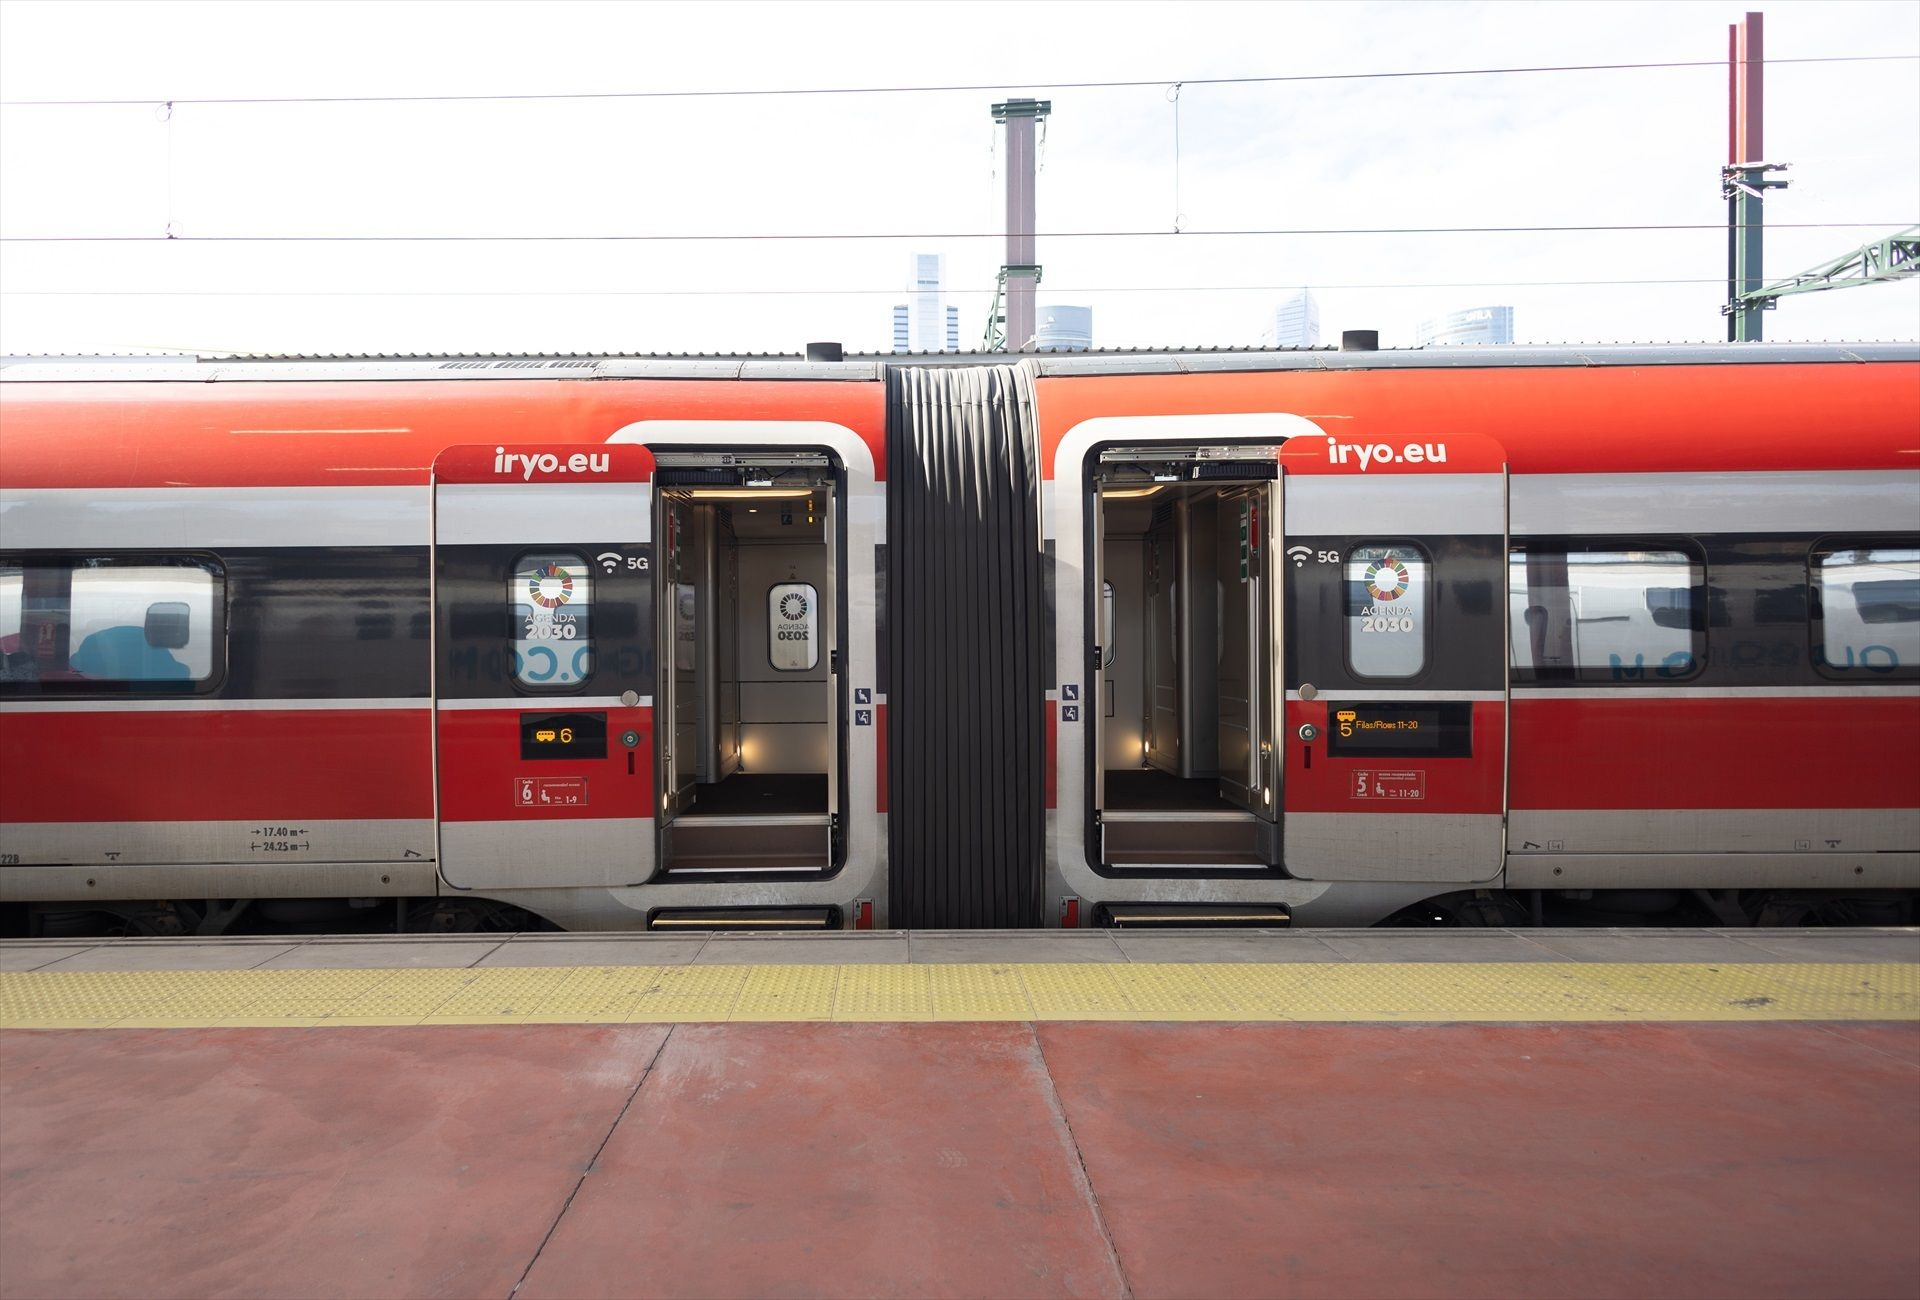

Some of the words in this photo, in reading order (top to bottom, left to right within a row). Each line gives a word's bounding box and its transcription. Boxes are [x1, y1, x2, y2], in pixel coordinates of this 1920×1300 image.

[1327, 436, 1447, 472] iryo.eu
[494, 446, 610, 481] iryo.eu
[627, 557, 649, 570] 5G
[1317, 550, 1340, 564] 5G
[524, 613, 577, 623] AGENDA
[1360, 606, 1414, 617] AGENDA
[524, 624, 577, 640] 2030
[1360, 617, 1415, 633] 2030
[1340, 722, 1352, 737] 5
[1356, 720, 1396, 729] Filas/Rows
[560, 728, 572, 743] 6
[1357, 776, 1367, 793] 5
[522, 784, 532, 801] 6
[565, 795, 577, 804] 1-9
[1399, 789, 1419, 798] 11-20
[263, 827, 288, 837] 17.40
[289, 829, 298, 837] m
[263, 841, 289, 851] 24.25
